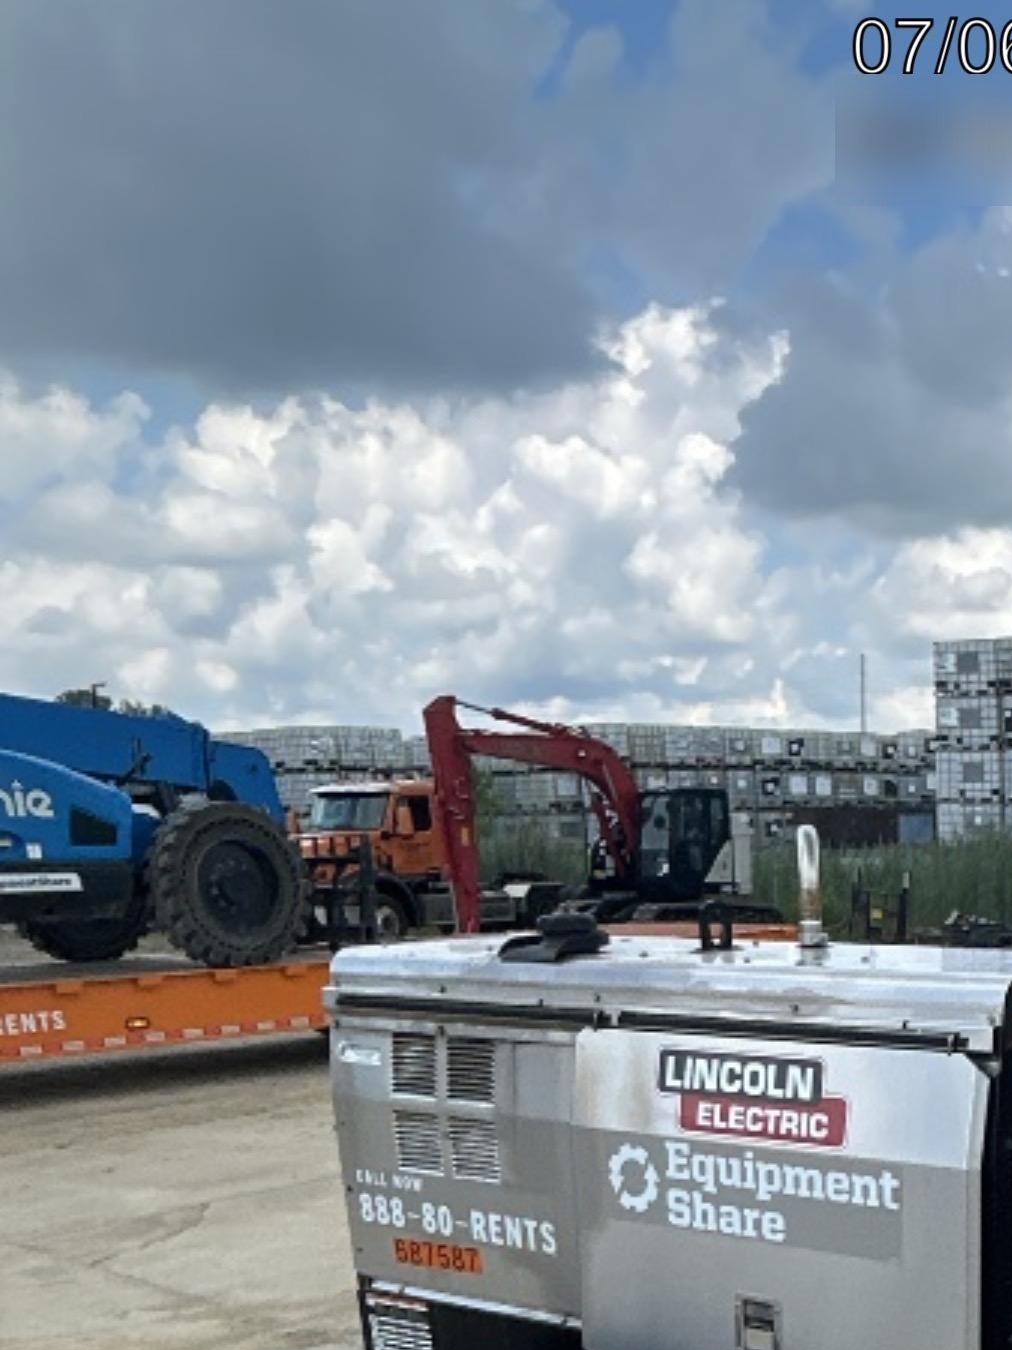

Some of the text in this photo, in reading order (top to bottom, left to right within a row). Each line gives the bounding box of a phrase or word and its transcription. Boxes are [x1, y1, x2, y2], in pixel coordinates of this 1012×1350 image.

[665, 1055, 814, 1101] LINCOLN
[695, 1102, 829, 1139] ELECTRIC
[356, 1169, 387, 1187] CALL
[664, 1140, 901, 1210] Equipment
[359, 1192, 557, 1256] 888-80-RENTS
[667, 1187, 787, 1243] Share
[393, 1238, 480, 1272] 687587
